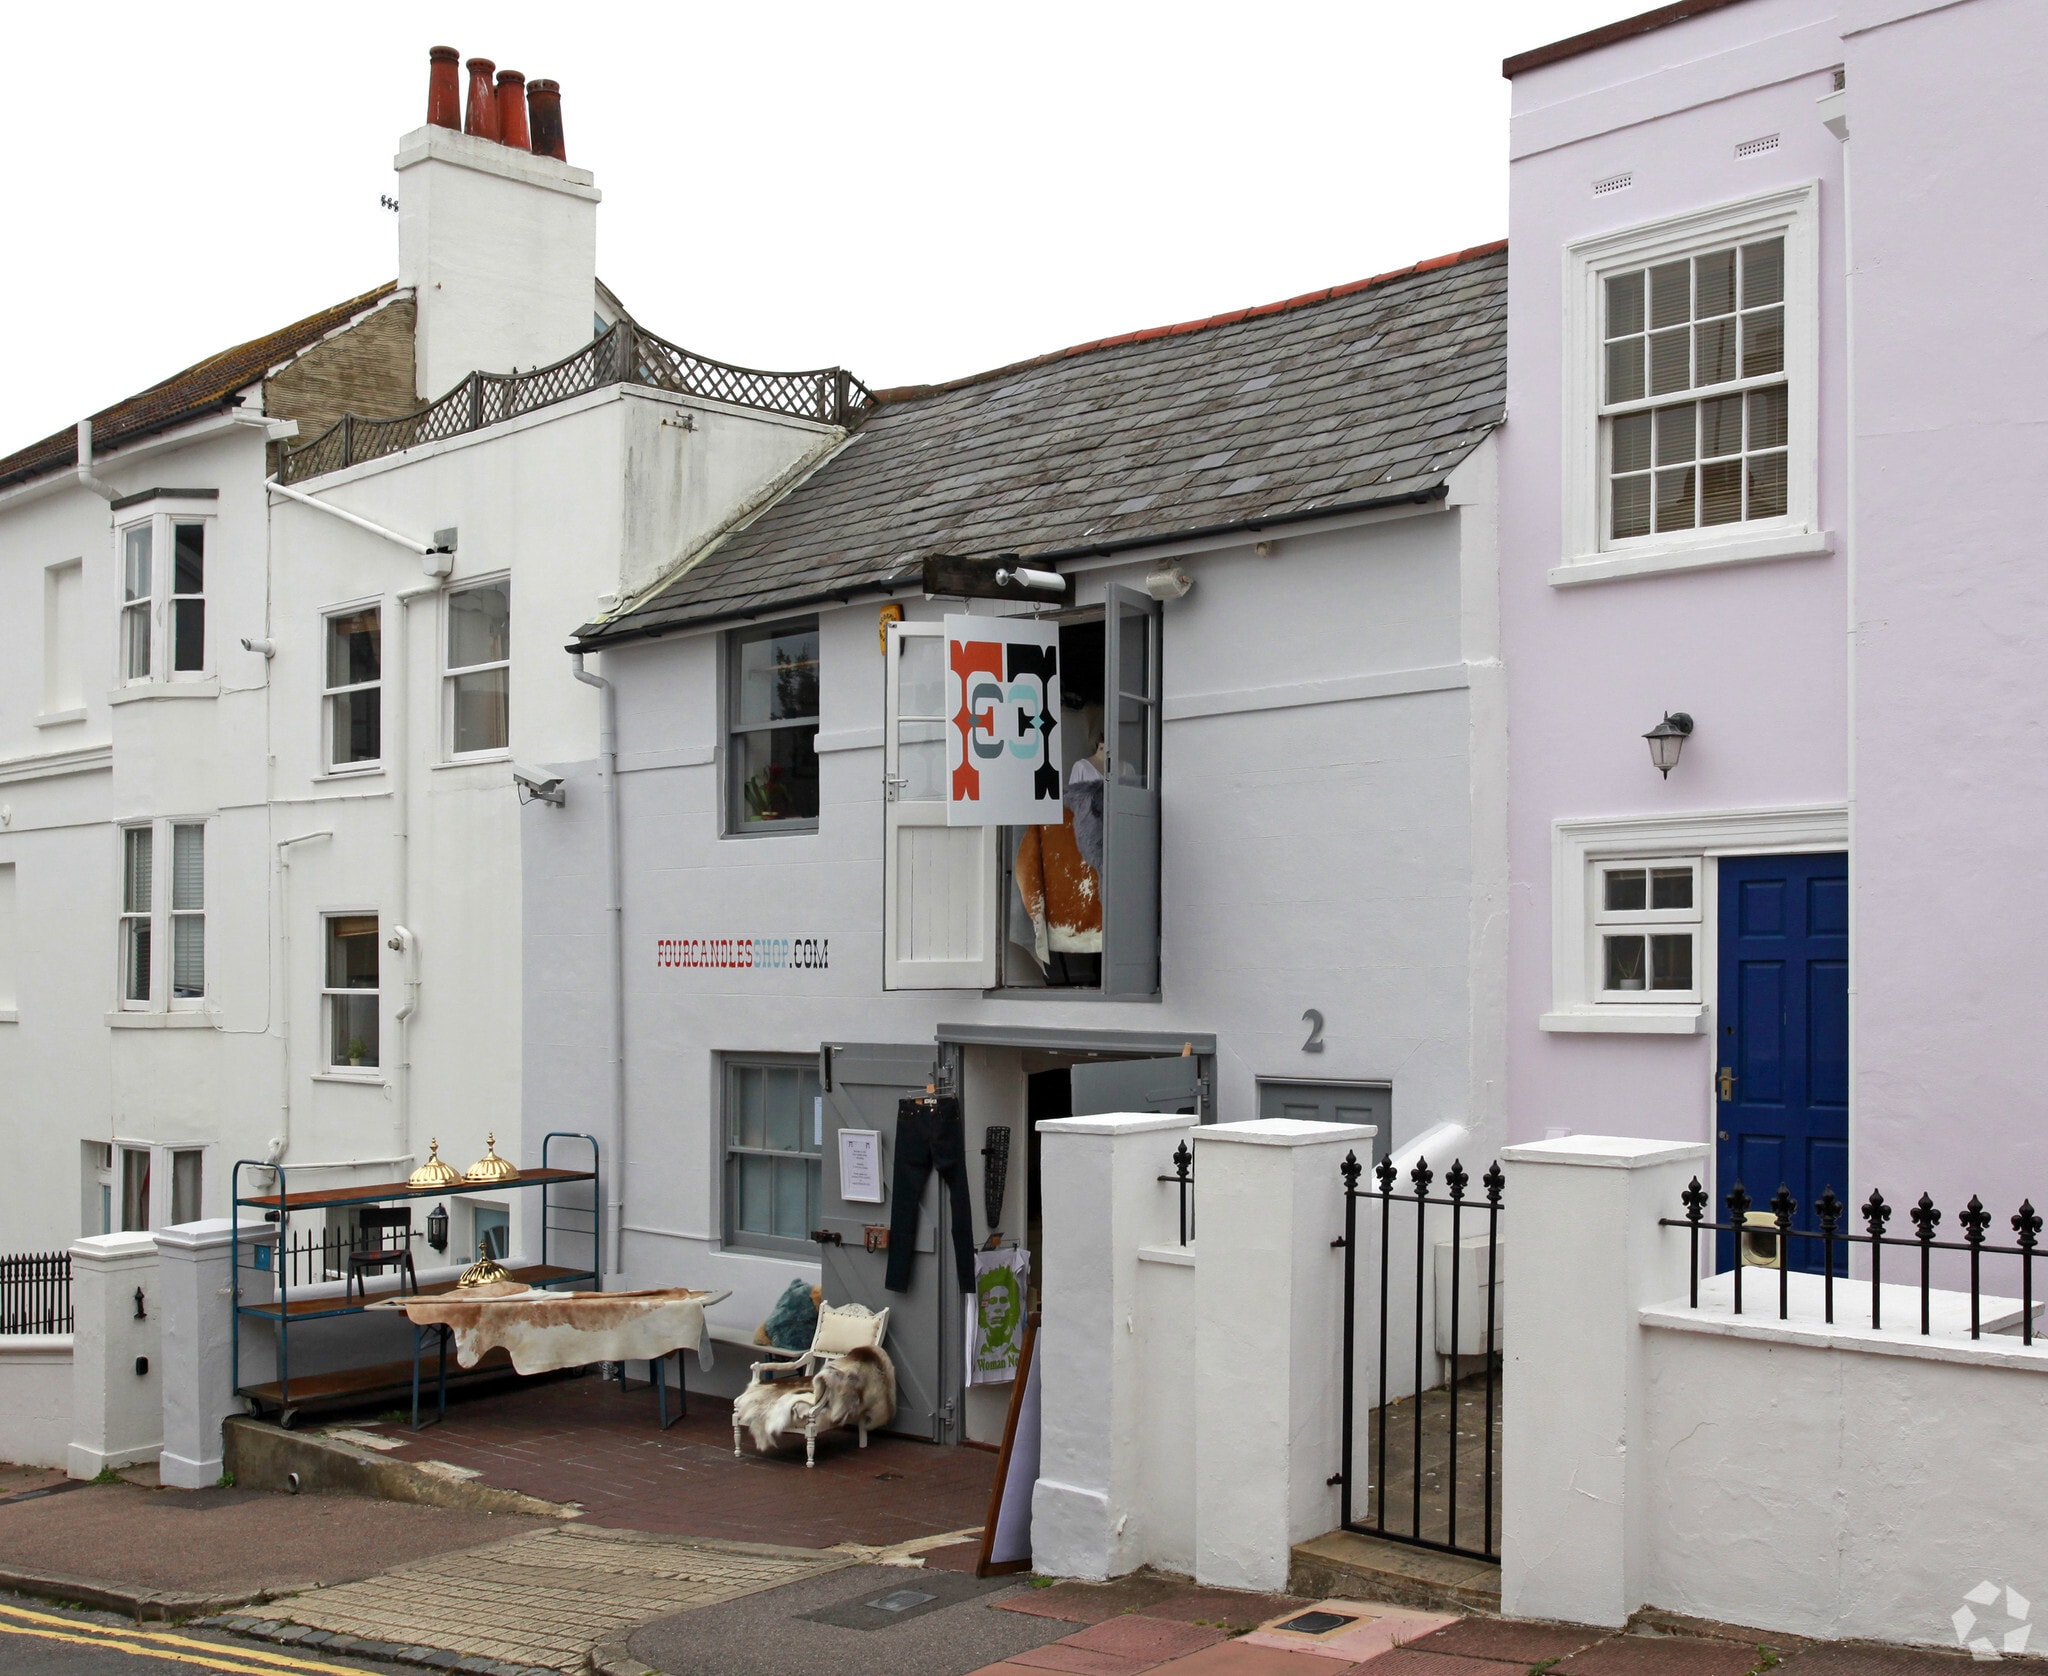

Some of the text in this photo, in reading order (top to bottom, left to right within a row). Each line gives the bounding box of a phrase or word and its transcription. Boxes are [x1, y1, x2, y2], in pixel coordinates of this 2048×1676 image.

[657, 938, 829, 969] FOURCANDLESSHOP.COM
[1301, 1008, 1325, 1053] 2
[977, 1358, 1006, 1371] Woman
